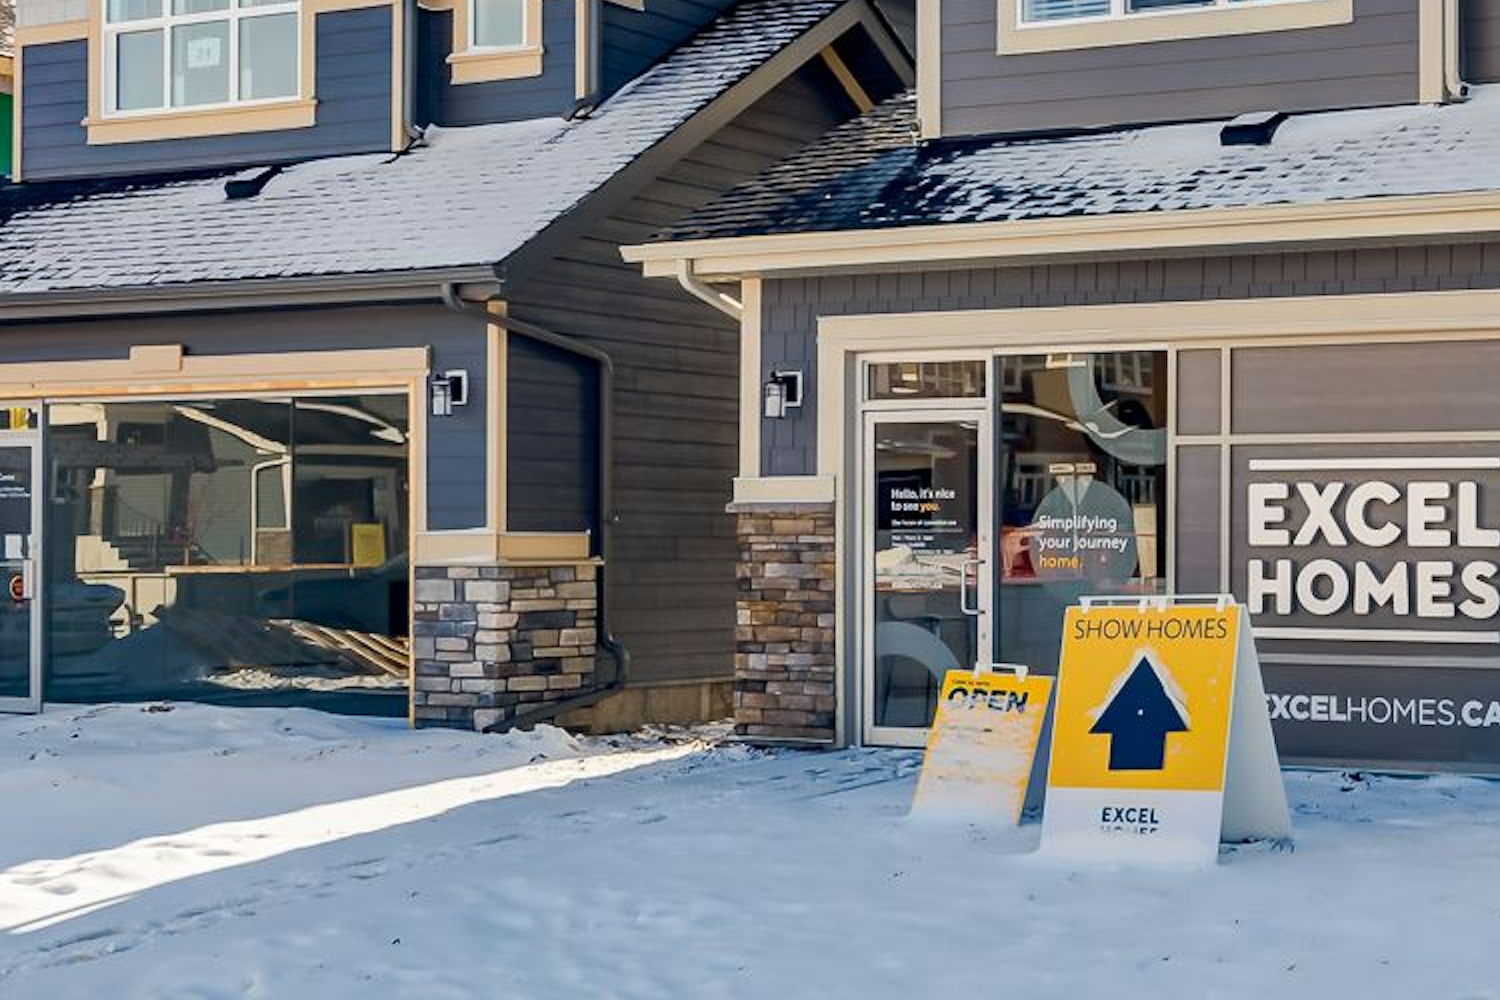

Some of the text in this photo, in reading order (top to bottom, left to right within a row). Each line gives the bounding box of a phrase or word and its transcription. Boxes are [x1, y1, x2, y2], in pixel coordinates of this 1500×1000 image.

[935, 487, 956, 500] nice
[891, 501, 902, 511] to
[903, 502, 919, 511] see
[1247, 481, 1500, 547] EXCEL
[1039, 515, 1117, 533] Simplifying
[1039, 537, 1129, 553] your journey
[1247, 558, 1500, 620] HOMES
[1075, 618, 1227, 639] SHOW HOMES
[1102, 807, 1159, 823] EXCEL
